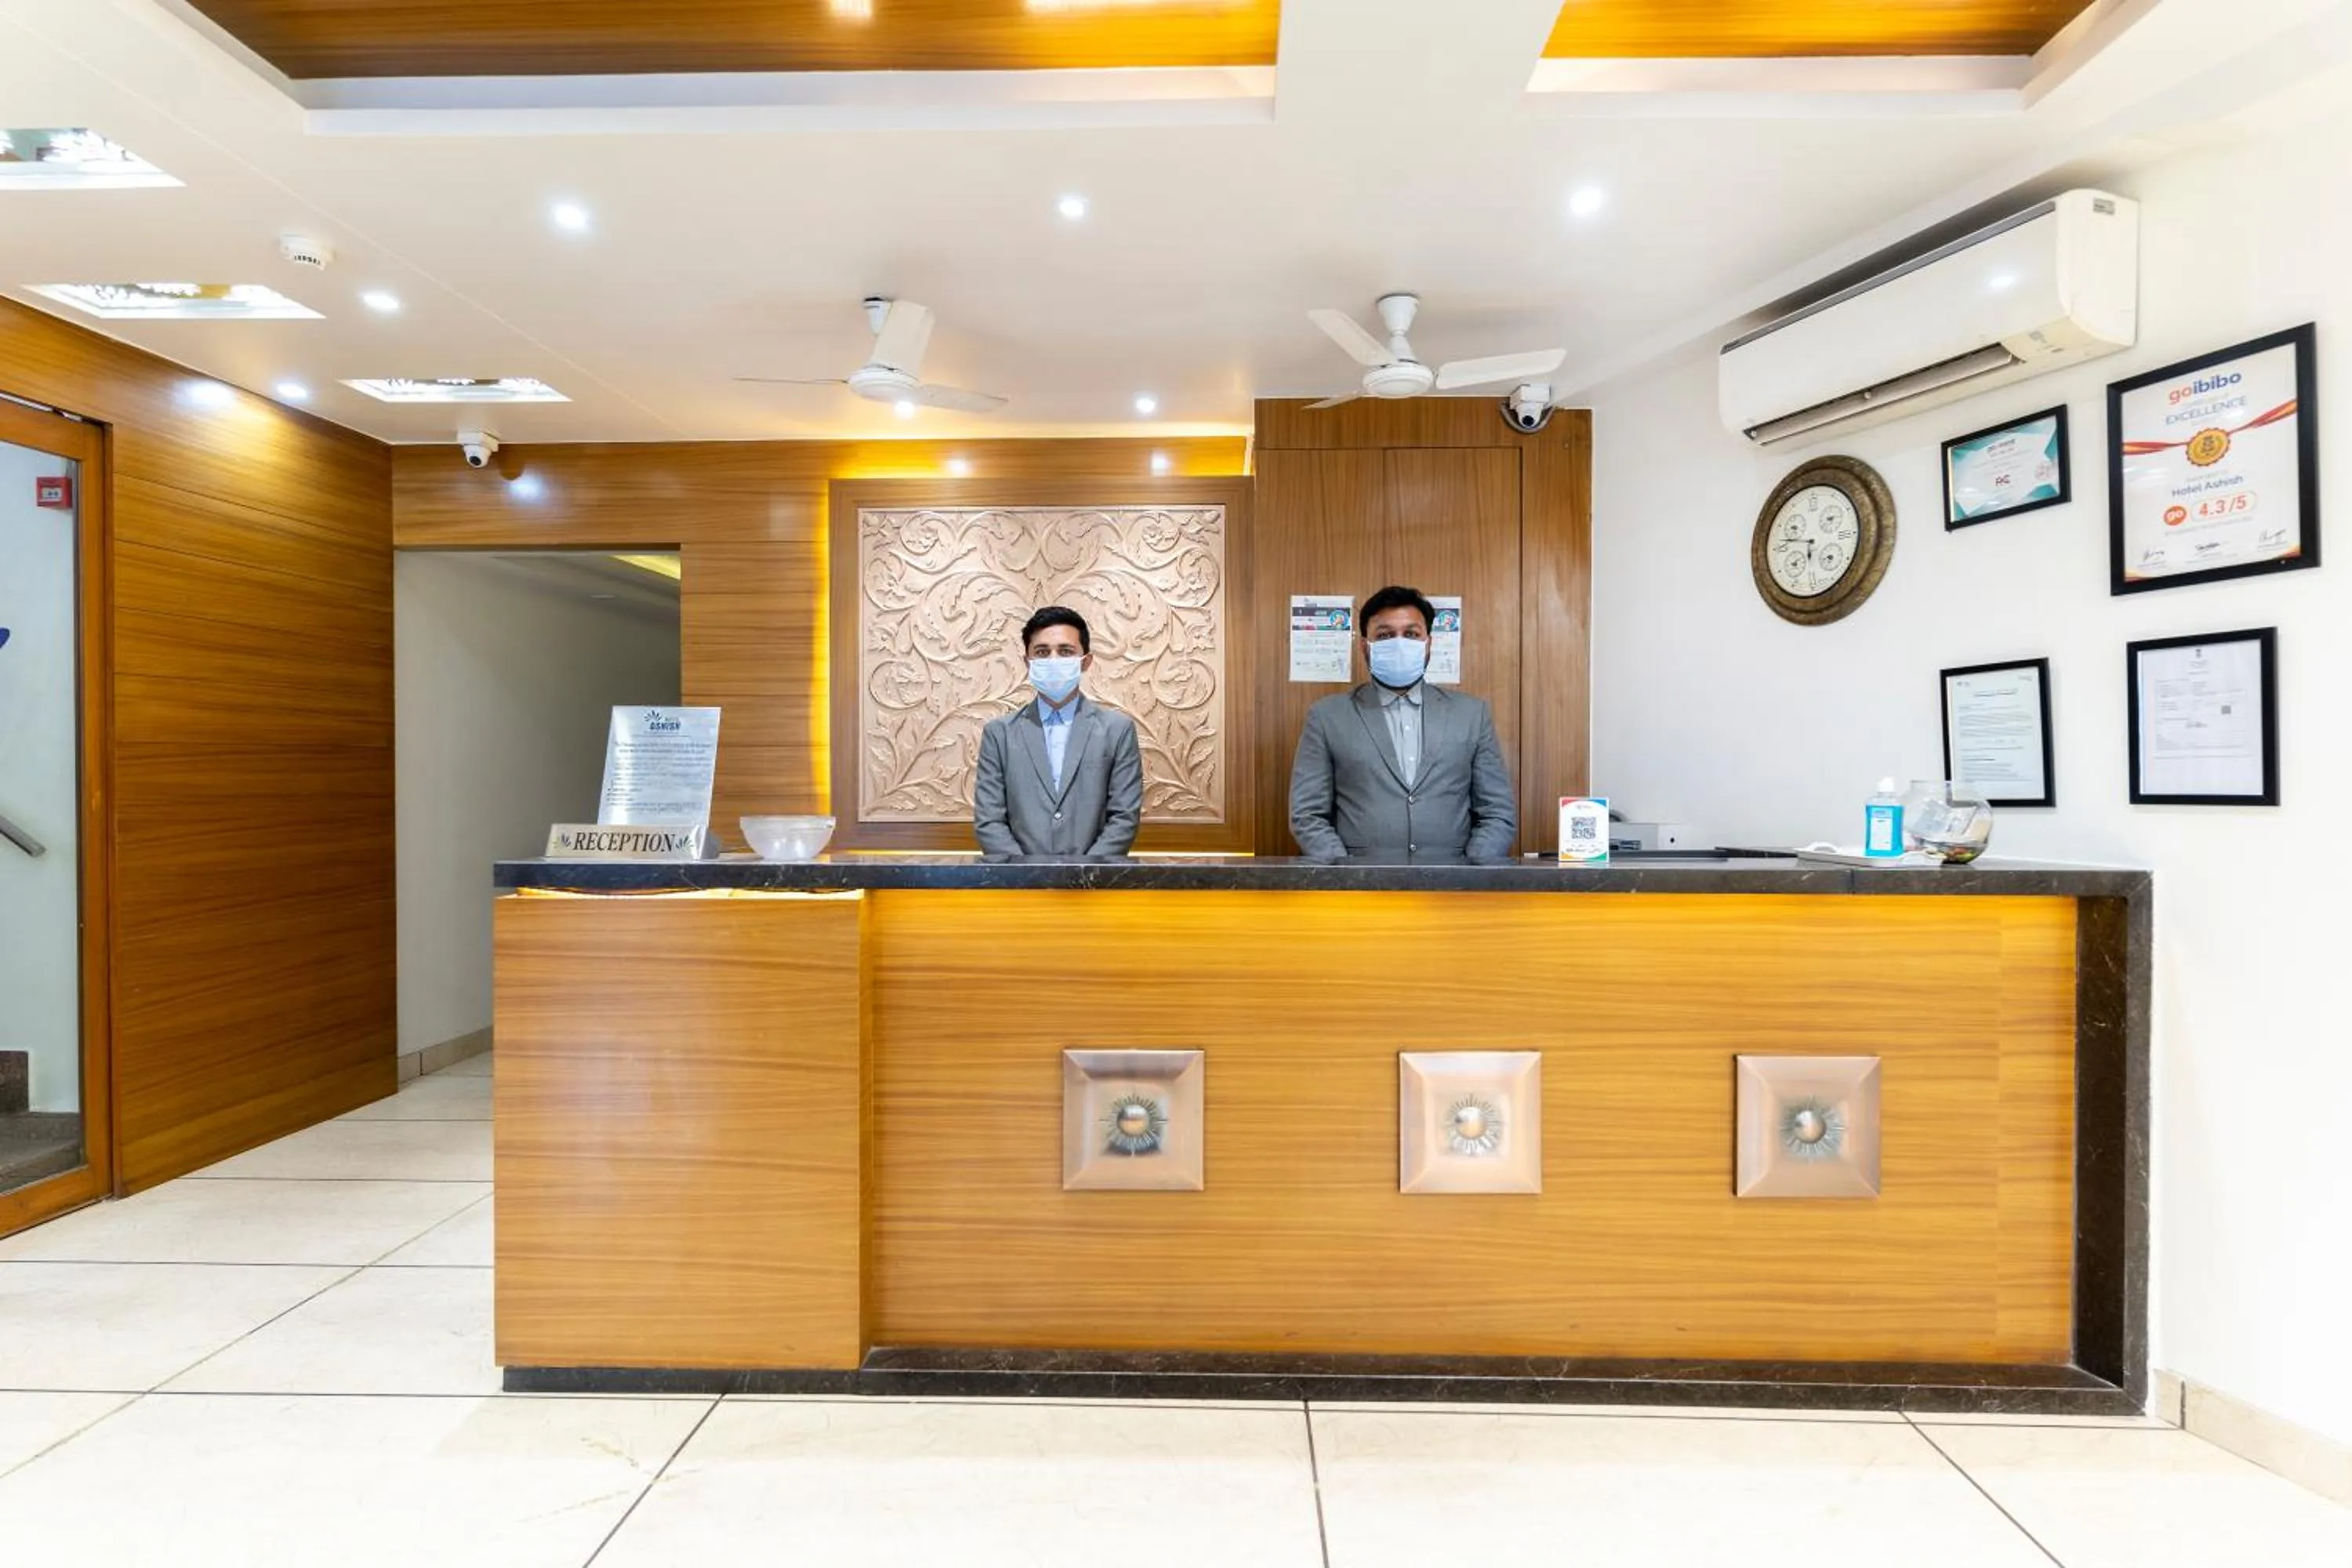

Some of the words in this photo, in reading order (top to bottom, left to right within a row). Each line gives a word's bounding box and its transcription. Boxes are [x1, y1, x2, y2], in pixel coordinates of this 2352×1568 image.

[2168, 372, 2241, 405] goibibo
[2165, 395, 2247, 425] EXCELLENCE
[2172, 483, 2202, 497] Hotel
[2205, 474, 2244, 490] Ashish
[2166, 510, 2184, 524] go
[572, 831, 676, 852] RECEPTION
